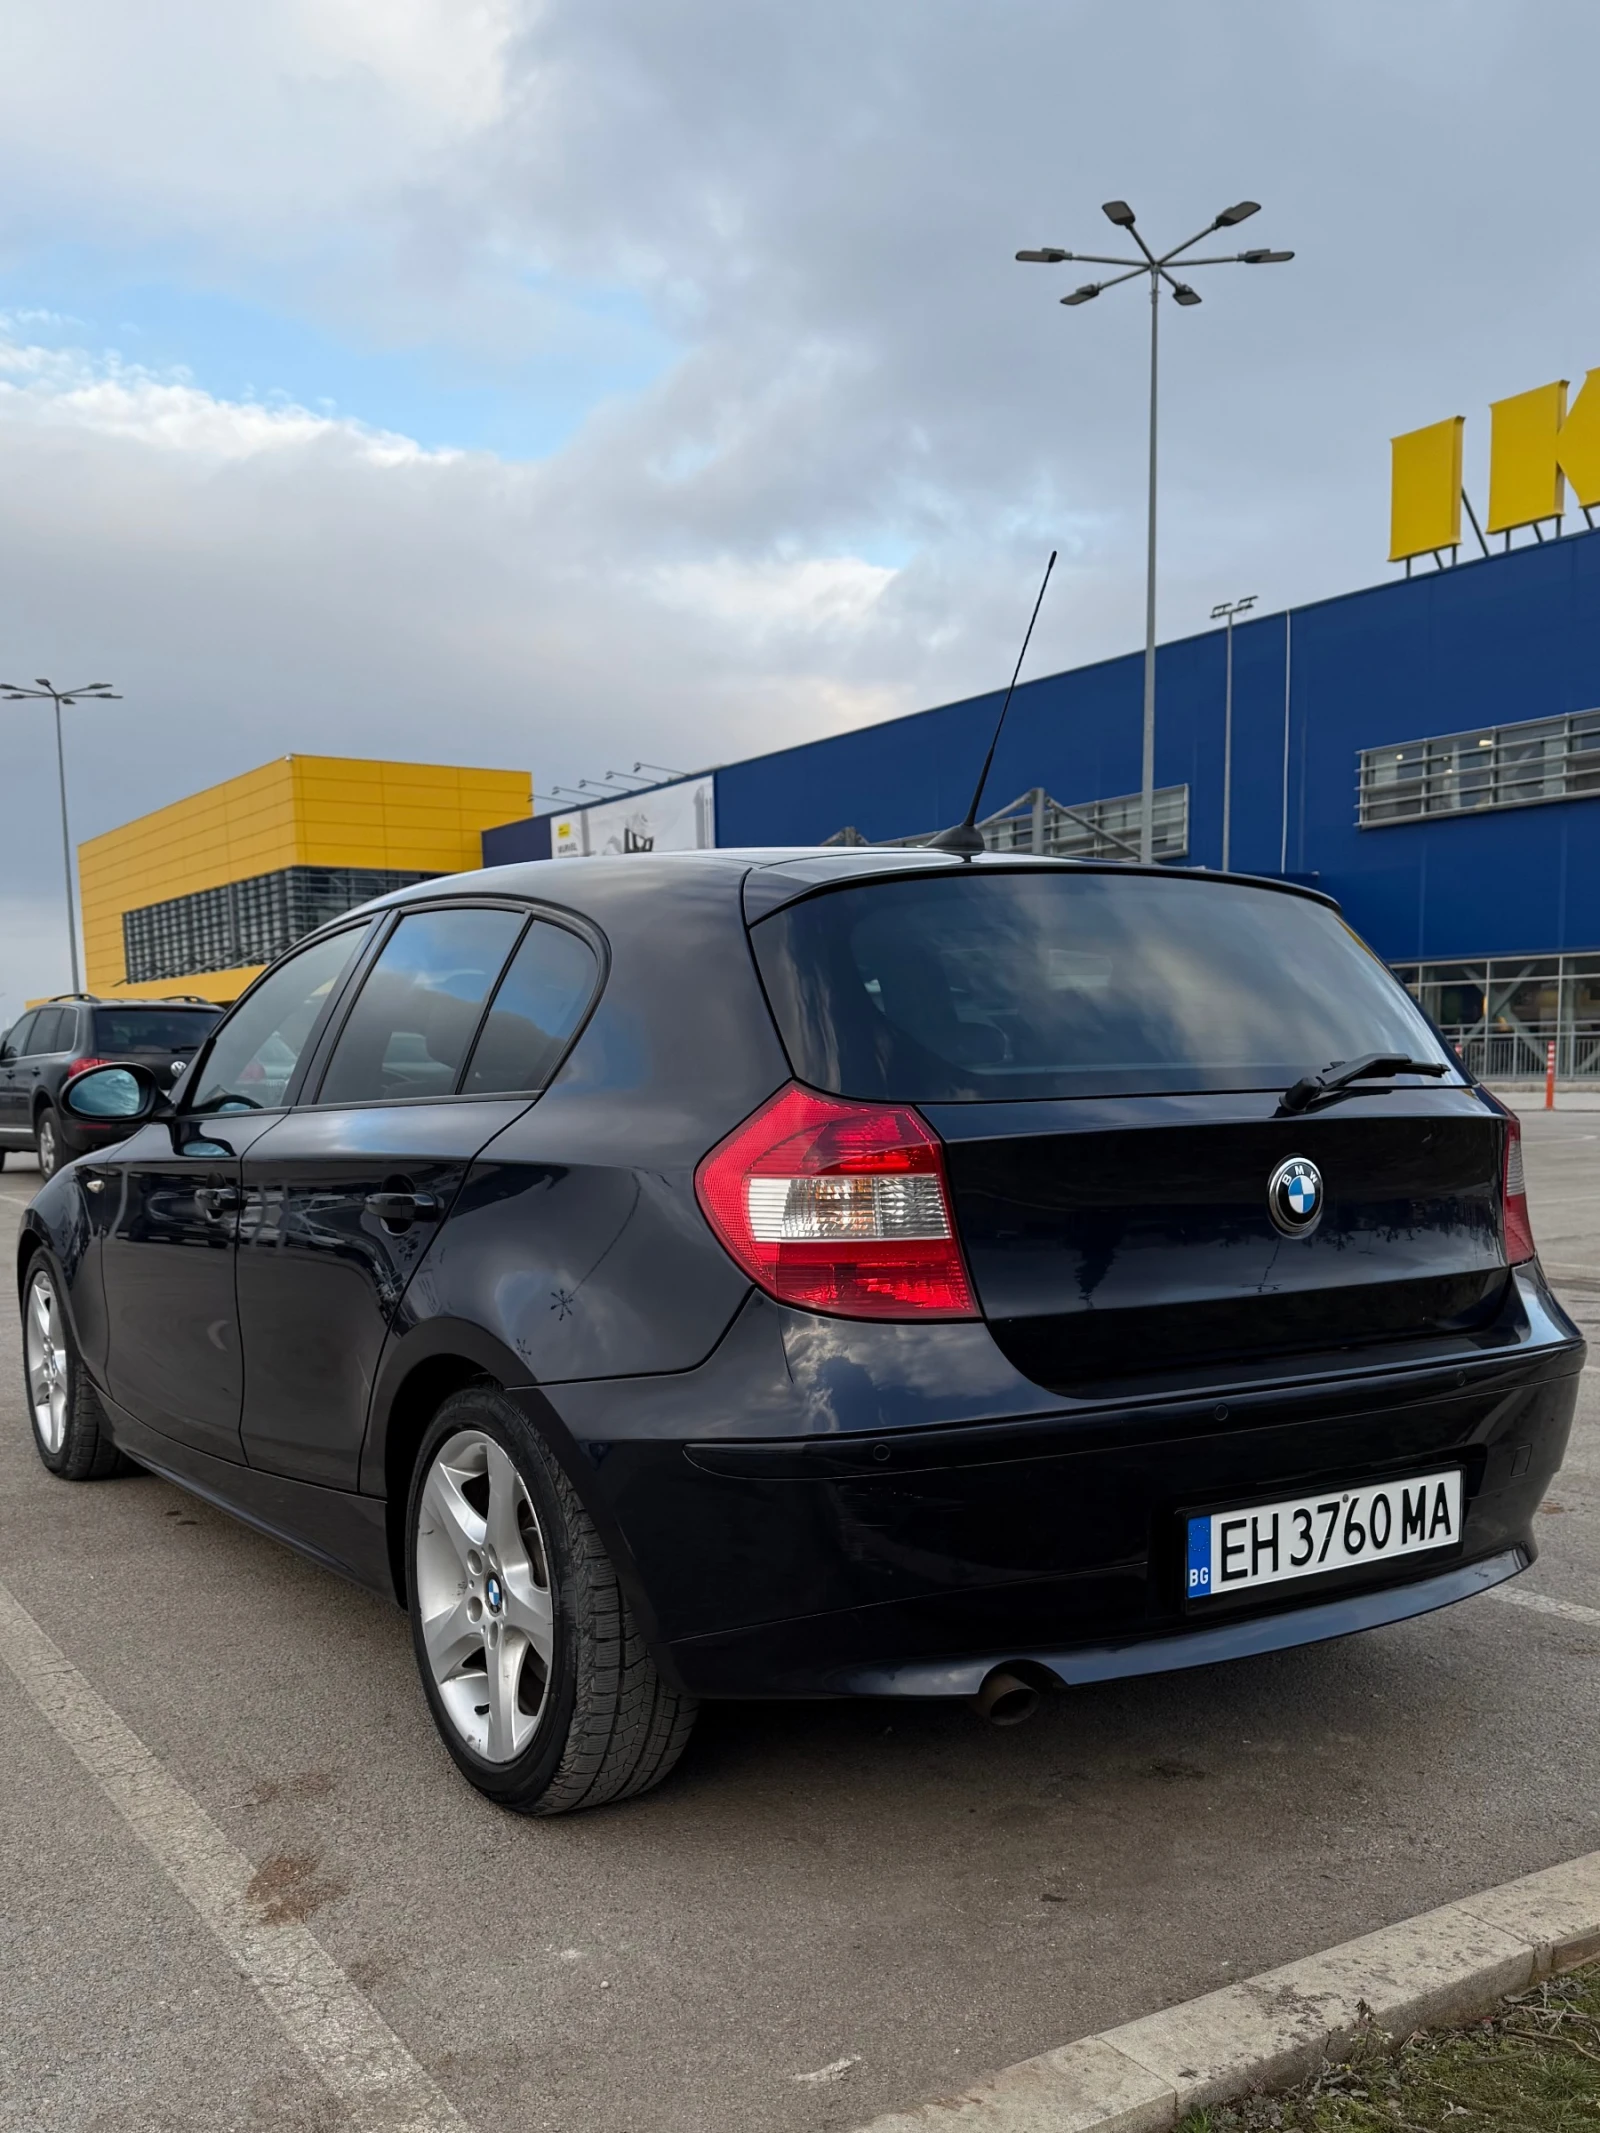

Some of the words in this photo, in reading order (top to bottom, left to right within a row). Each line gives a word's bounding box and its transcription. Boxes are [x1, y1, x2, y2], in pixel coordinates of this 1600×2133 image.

[1282, 1165, 1318, 1186] BMW
[1220, 1512, 1279, 1582] EH
[1290, 1493, 1391, 1566] 3760
[1402, 1481, 1452, 1545] MA
[1189, 1567, 1209, 1587] BG
